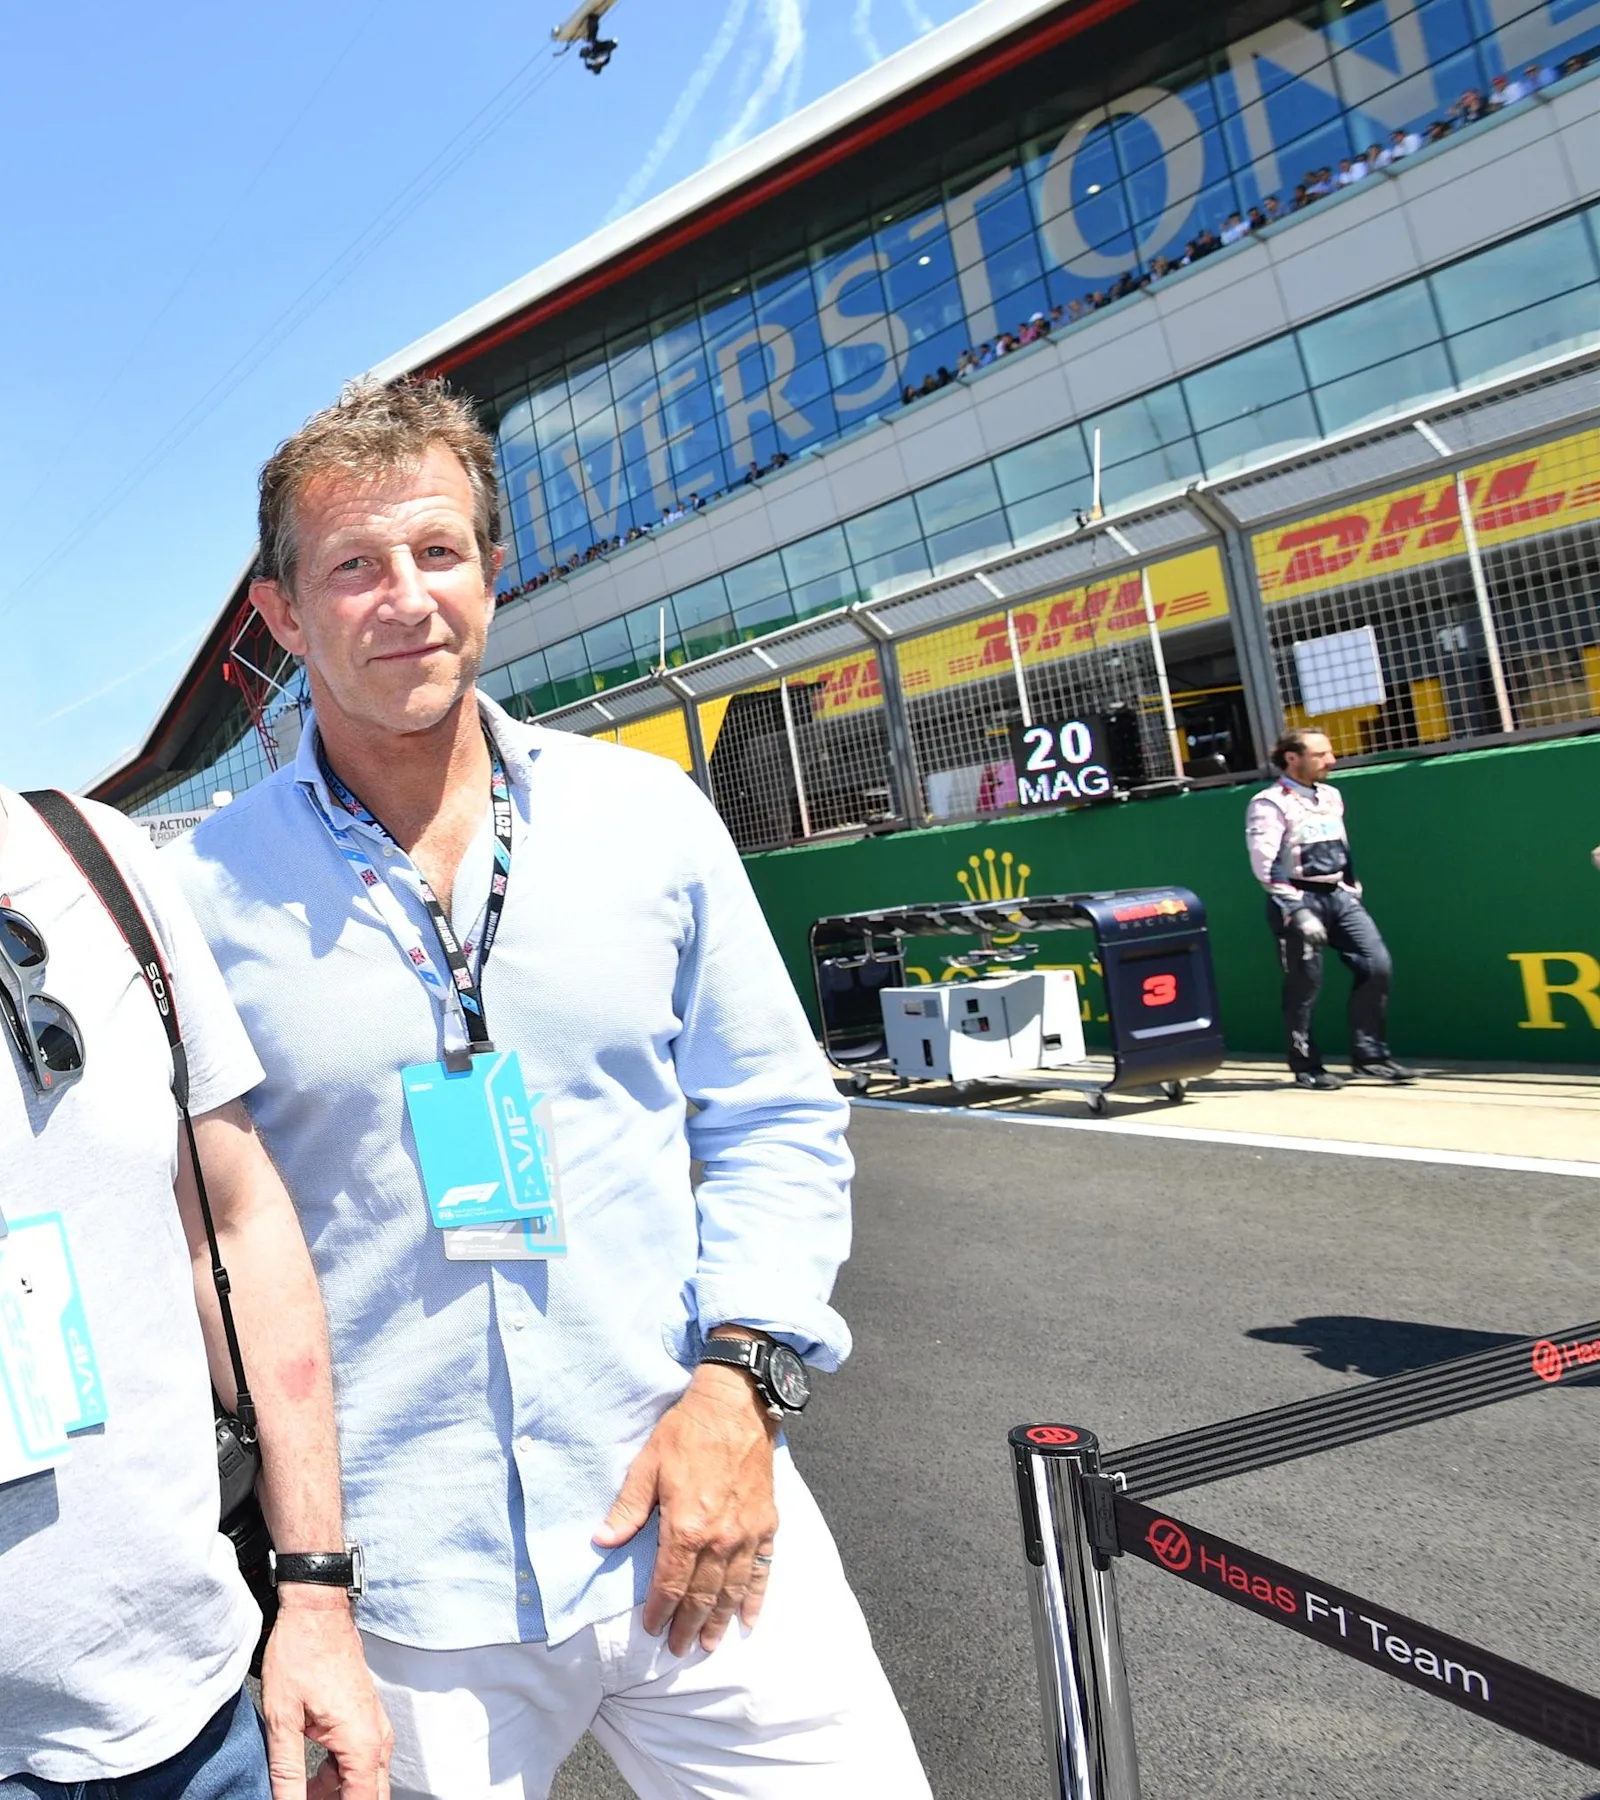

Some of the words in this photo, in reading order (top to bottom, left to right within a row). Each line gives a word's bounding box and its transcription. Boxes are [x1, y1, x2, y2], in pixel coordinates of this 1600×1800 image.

[1276, 460, 1566, 586] DHL
[976, 580, 1167, 667] DHL
[1023, 721, 1092, 770] 20
[1018, 765, 1110, 803] MAG
[145, 961, 170, 1017] EOS
[1142, 973, 1178, 1008] 3
[502, 1095, 535, 1174] VIP
[67, 1327, 95, 1396] VIP
[1200, 1544, 1297, 1614] Haas
[1304, 1590, 1347, 1638] F1
[1359, 1614, 1490, 1702] Team
